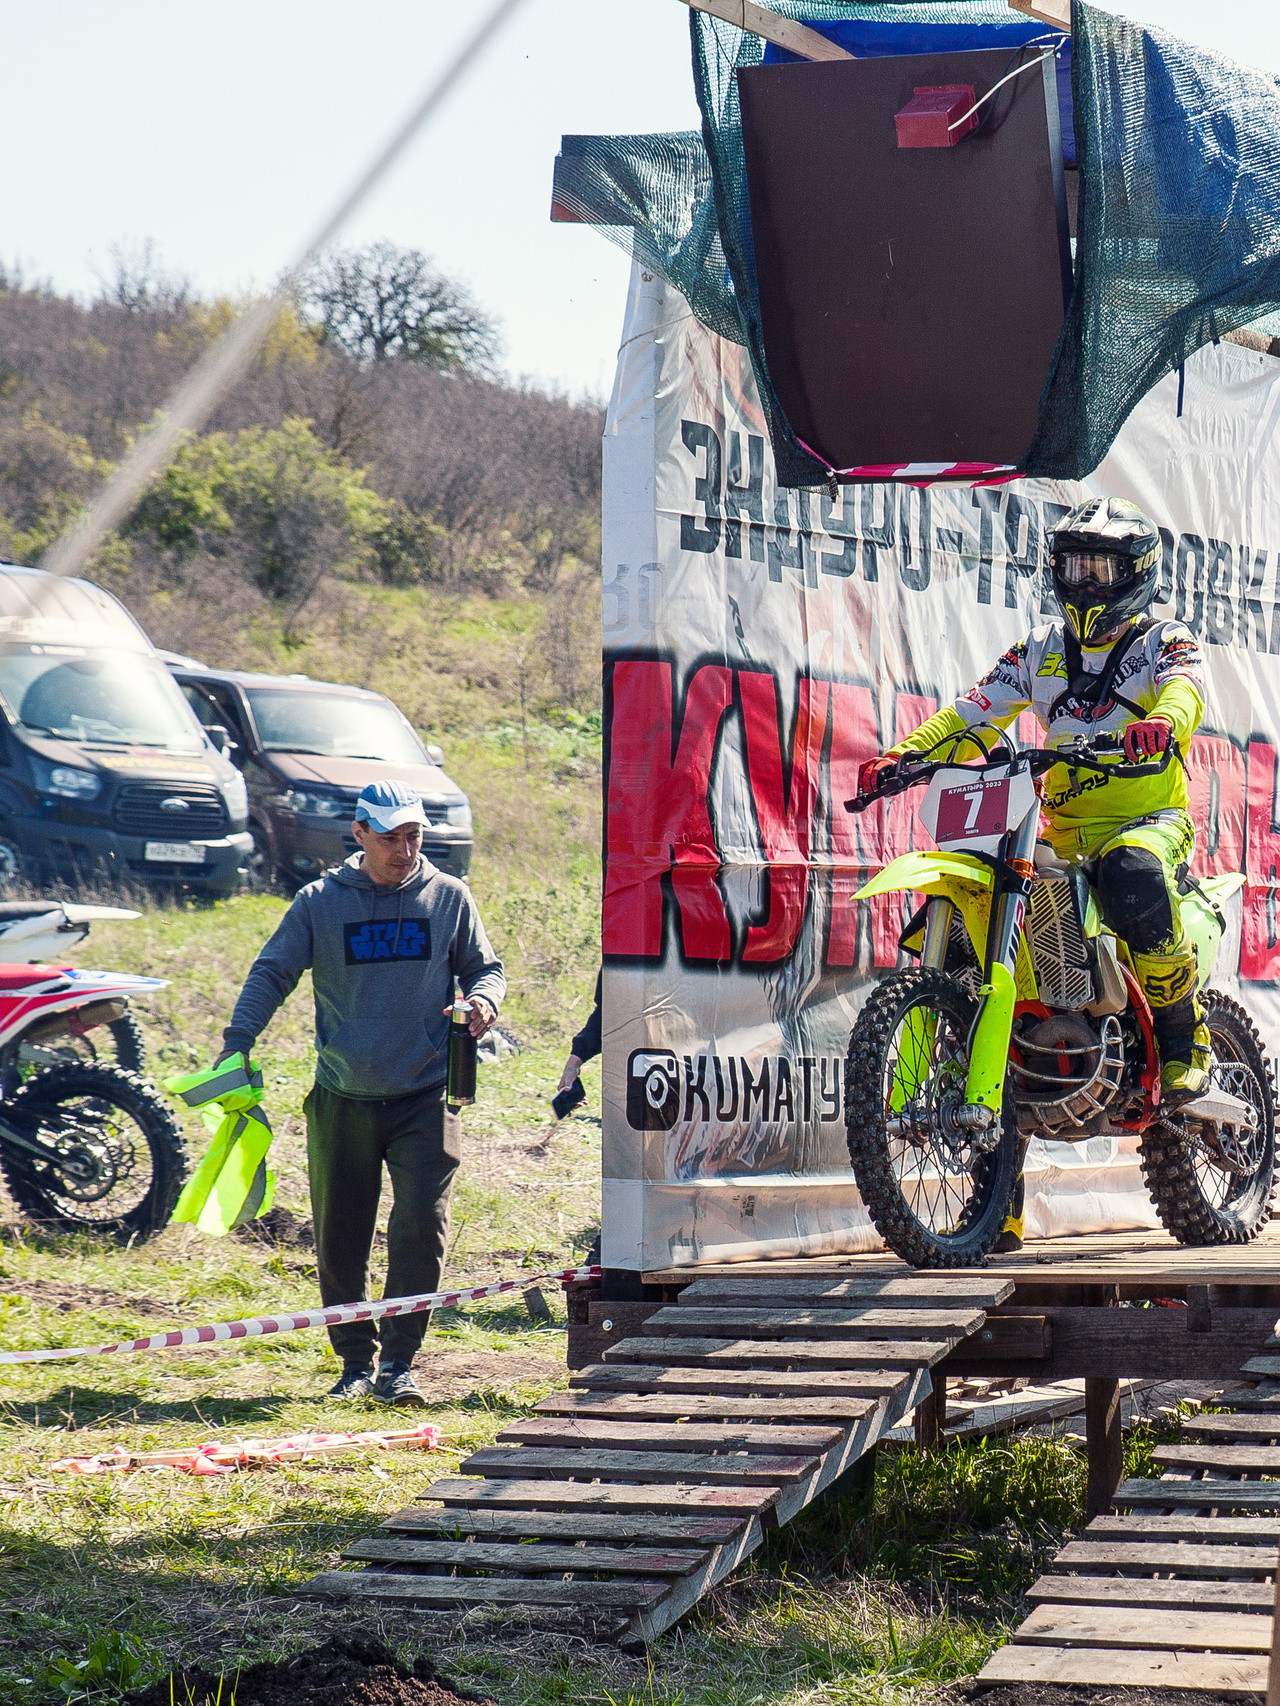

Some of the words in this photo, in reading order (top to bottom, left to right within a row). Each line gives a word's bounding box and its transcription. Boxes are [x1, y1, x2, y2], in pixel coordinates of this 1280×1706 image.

[948, 782, 984, 795] КУМАТЫРЬ
[964, 791, 983, 829] 7
[351, 922, 425, 941] STAR
[351, 939, 425, 959] WARS
[683, 1056, 848, 1123] KUMATY
